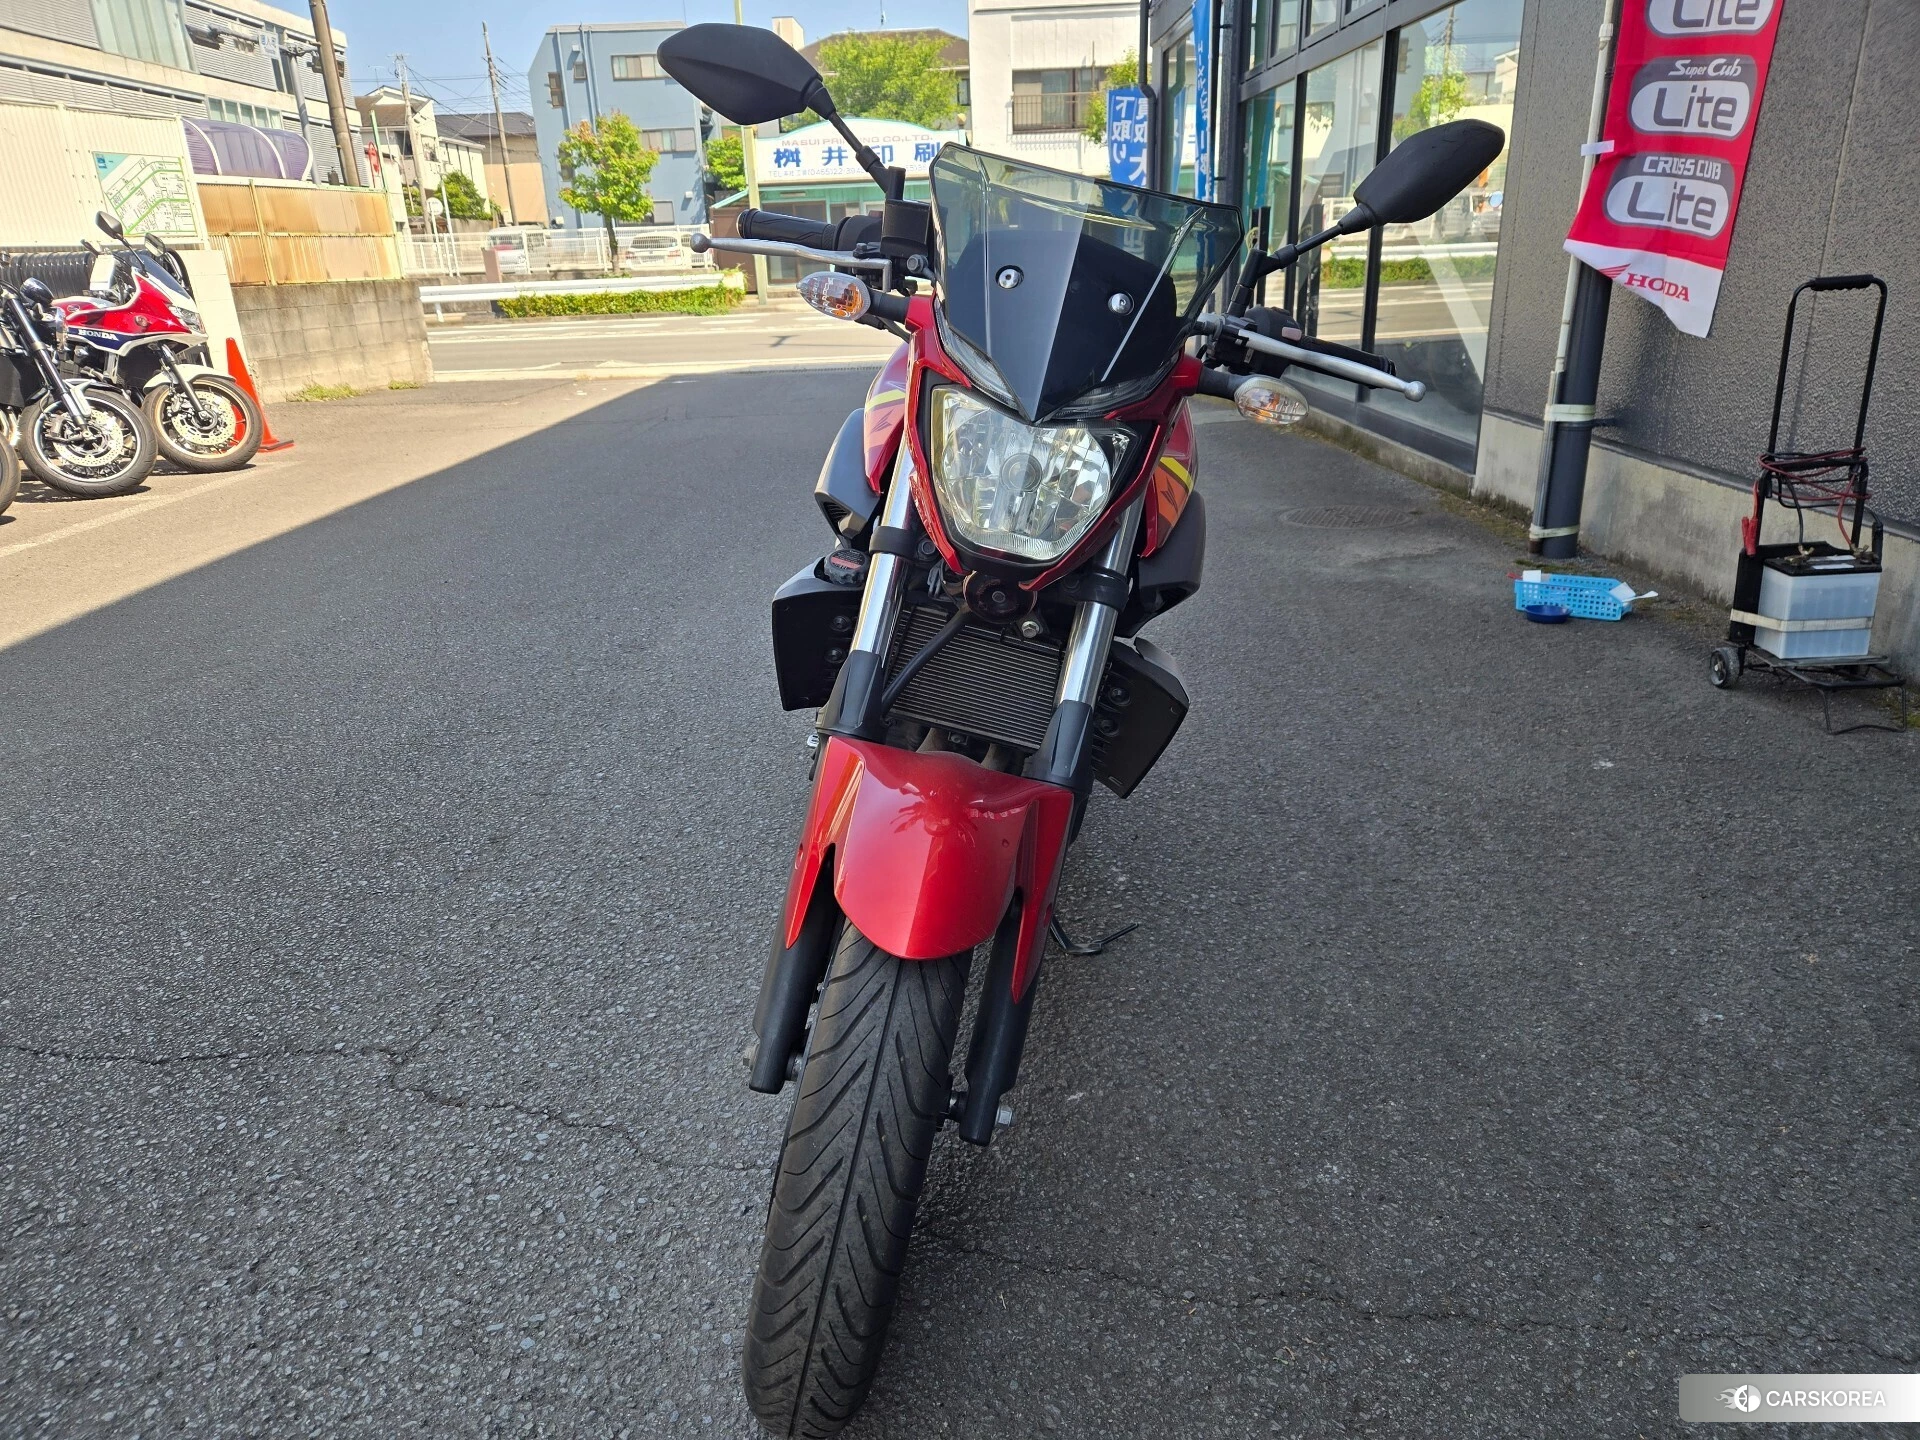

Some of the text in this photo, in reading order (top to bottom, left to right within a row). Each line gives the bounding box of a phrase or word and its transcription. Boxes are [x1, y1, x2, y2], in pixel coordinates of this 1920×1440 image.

[1668, 58, 1742, 78] Super Cub
[1653, 84, 1738, 131] Lite
[781, 139, 820, 147] MASUI
[1642, 156, 1722, 180] CROSS CUB
[1627, 181, 1717, 231] Lite
[1624, 272, 1690, 302] HODA
[78, 329, 119, 341] HONDA
